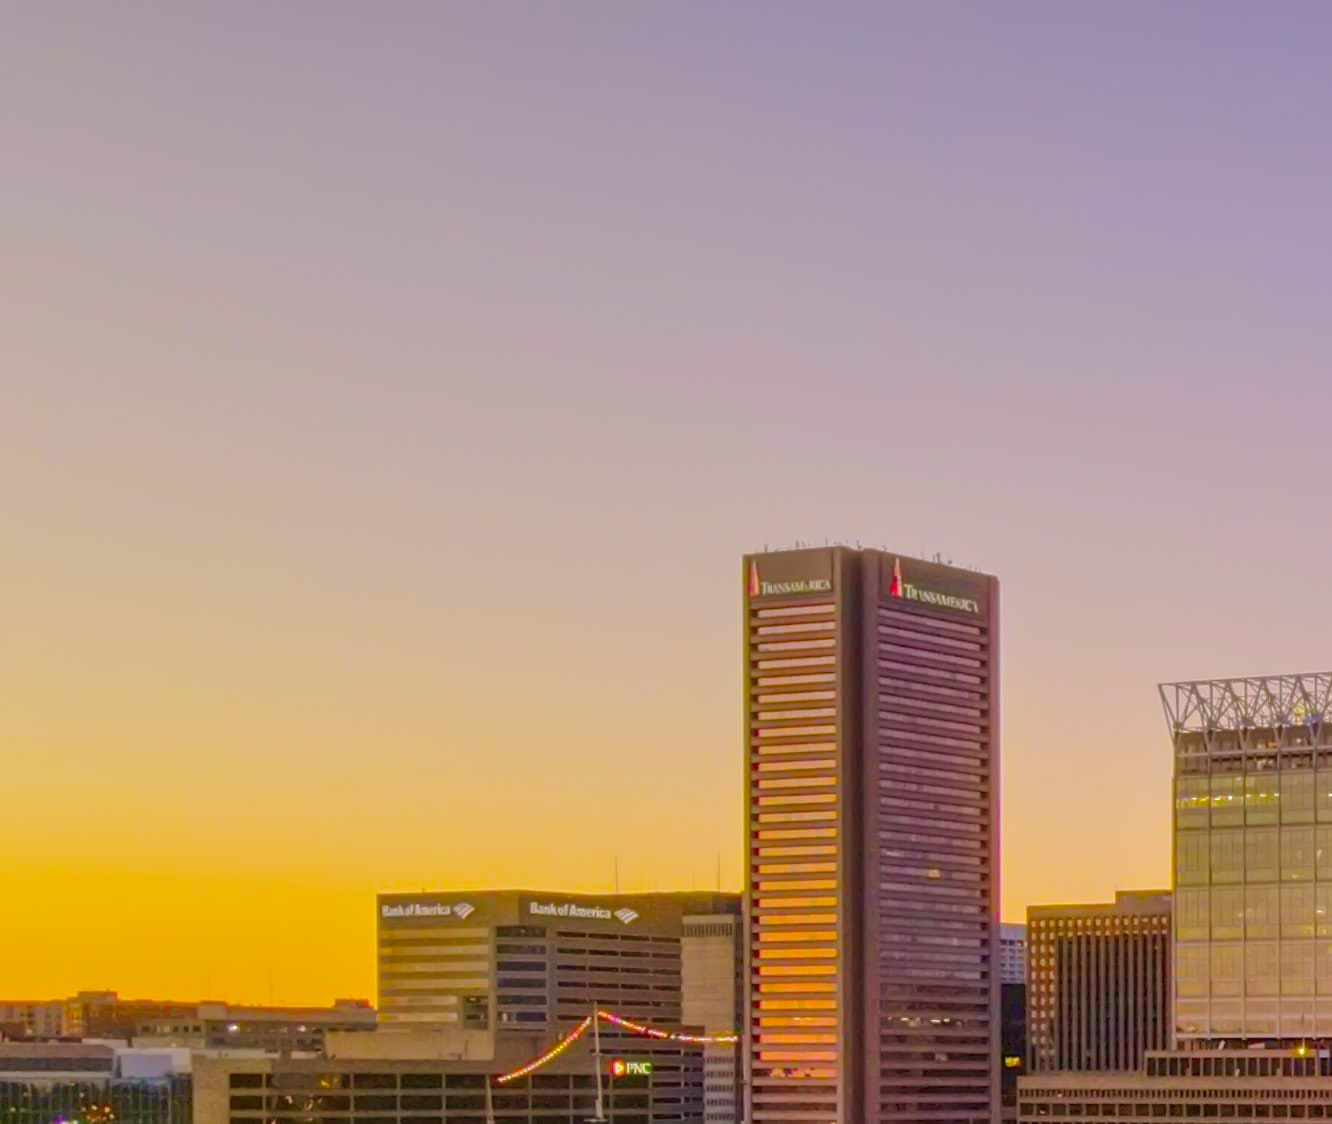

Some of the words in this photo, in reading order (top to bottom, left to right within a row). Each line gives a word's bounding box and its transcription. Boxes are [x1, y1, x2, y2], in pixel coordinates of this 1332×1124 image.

[382, 903, 404, 917] Bank
[404, 903, 414, 916] of
[415, 902, 451, 916] America
[529, 902, 557, 916] Bank
[557, 903, 569, 916] of
[569, 904, 611, 919] America
[626, 1061, 652, 1074] PNC
